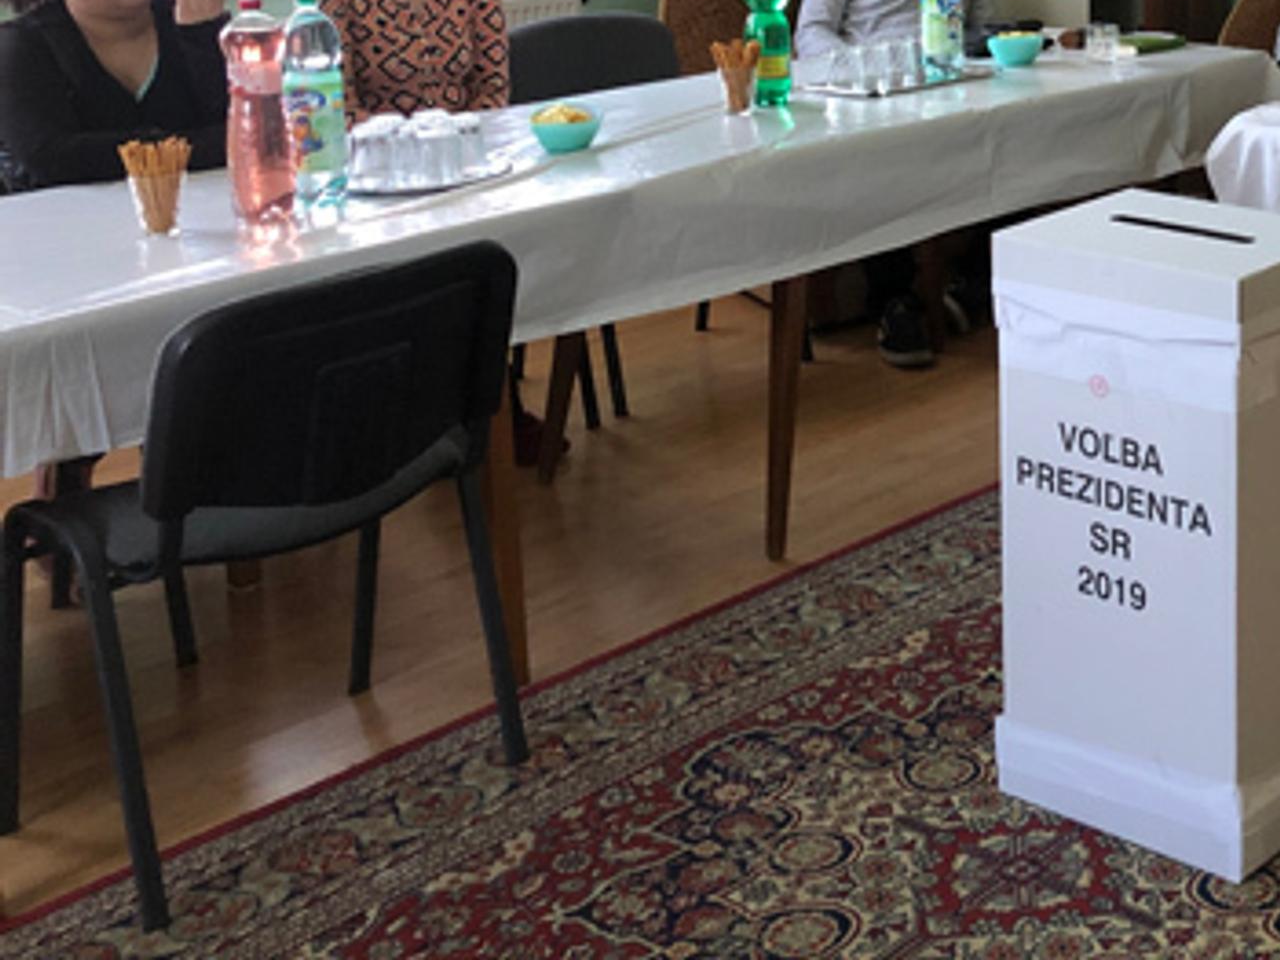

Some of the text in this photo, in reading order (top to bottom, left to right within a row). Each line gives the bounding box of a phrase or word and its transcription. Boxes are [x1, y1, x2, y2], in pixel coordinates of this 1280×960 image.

[1016, 456, 1212, 537] PREZIDENTA
[1089, 521, 1132, 560] SR
[1077, 565, 1147, 611] 2019
